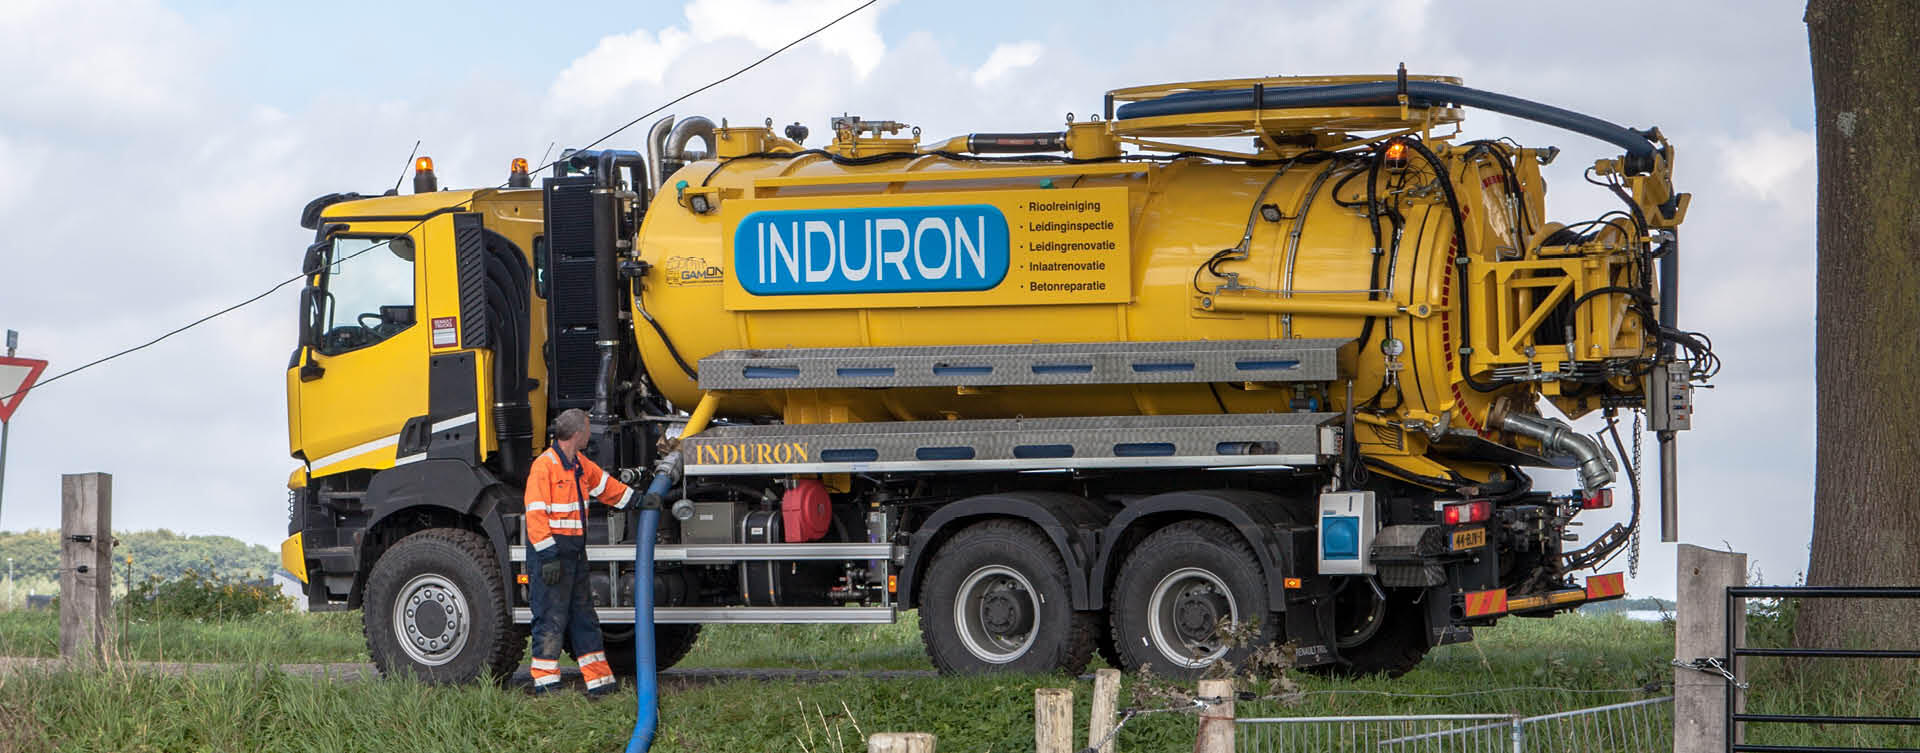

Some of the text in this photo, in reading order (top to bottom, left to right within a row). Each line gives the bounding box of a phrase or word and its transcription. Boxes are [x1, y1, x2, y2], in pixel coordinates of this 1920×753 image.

[1029, 200, 1101, 213] Rioolreiniging
[1029, 220, 1114, 233] Leidinginspectie
[758, 216, 986, 284] INDURON
[1029, 240, 1116, 253] Leidingrenovatie
[1029, 260, 1106, 272] Inlaatrenovatie
[1030, 280, 1106, 293] Betonreparatie
[695, 442, 809, 465] INDURON
